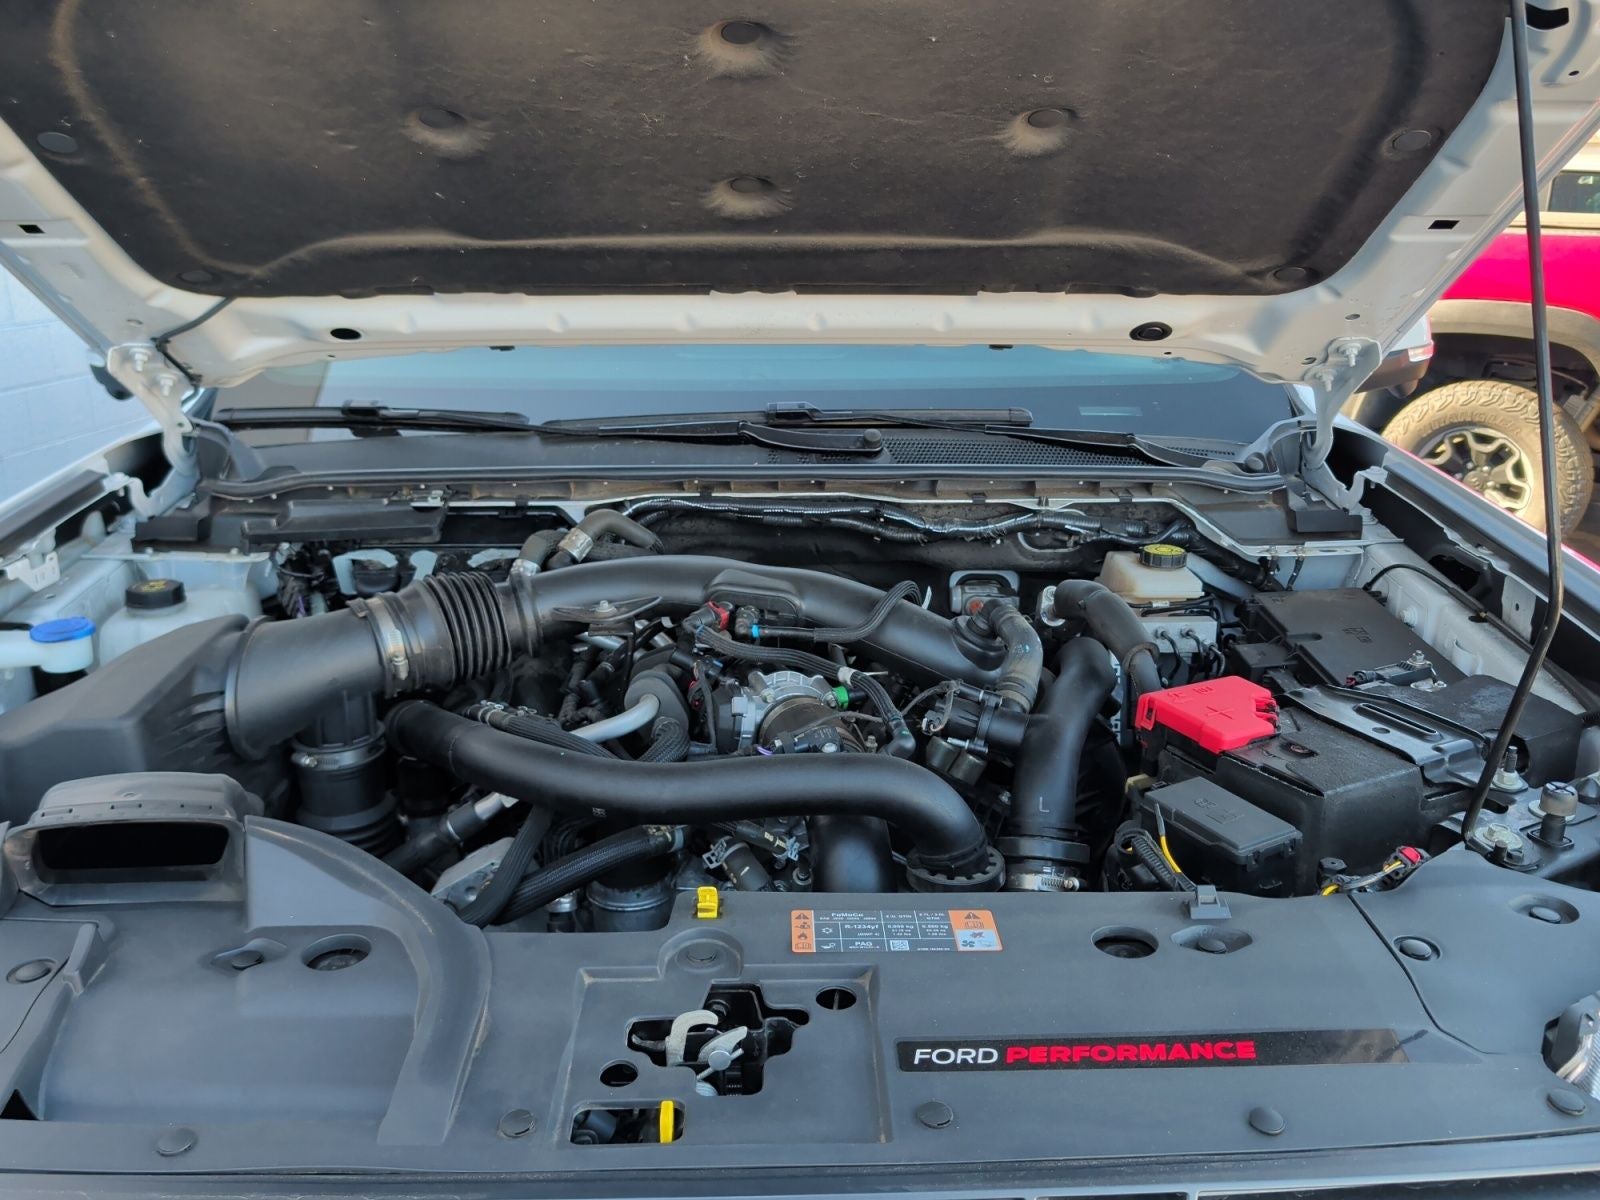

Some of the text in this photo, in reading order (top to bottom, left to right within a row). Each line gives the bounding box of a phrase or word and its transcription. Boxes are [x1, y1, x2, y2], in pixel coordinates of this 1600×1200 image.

[1039, 796, 1050, 813] L
[913, 1041, 1256, 1064] FORD PERFORMANCE
